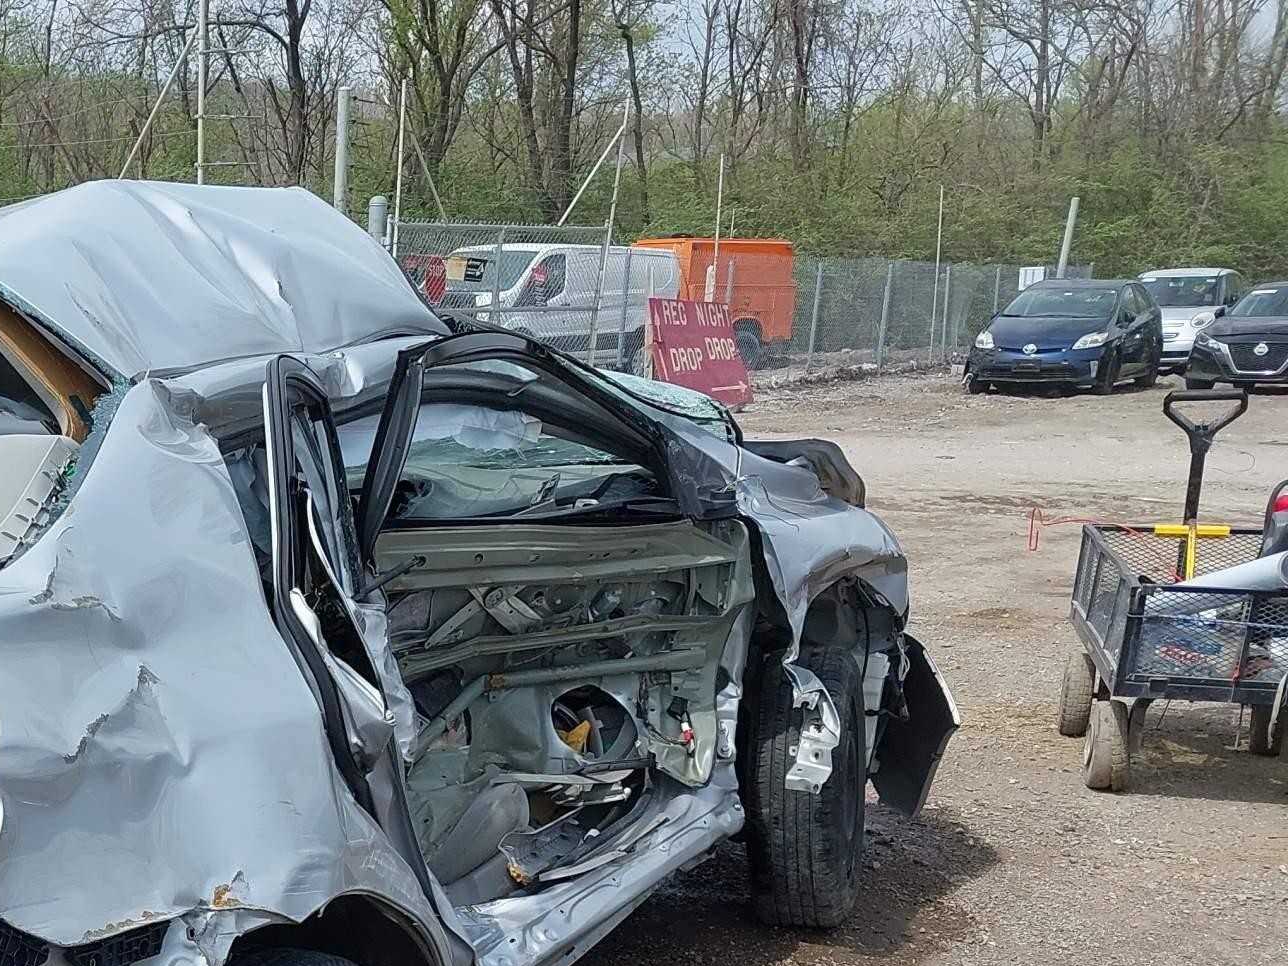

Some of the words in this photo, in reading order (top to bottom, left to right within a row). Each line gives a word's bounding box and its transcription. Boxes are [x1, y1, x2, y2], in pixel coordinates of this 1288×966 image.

[695, 303, 730, 328] NIGHT
[670, 347, 703, 372] DROP
[704, 337, 736, 361] DROP
